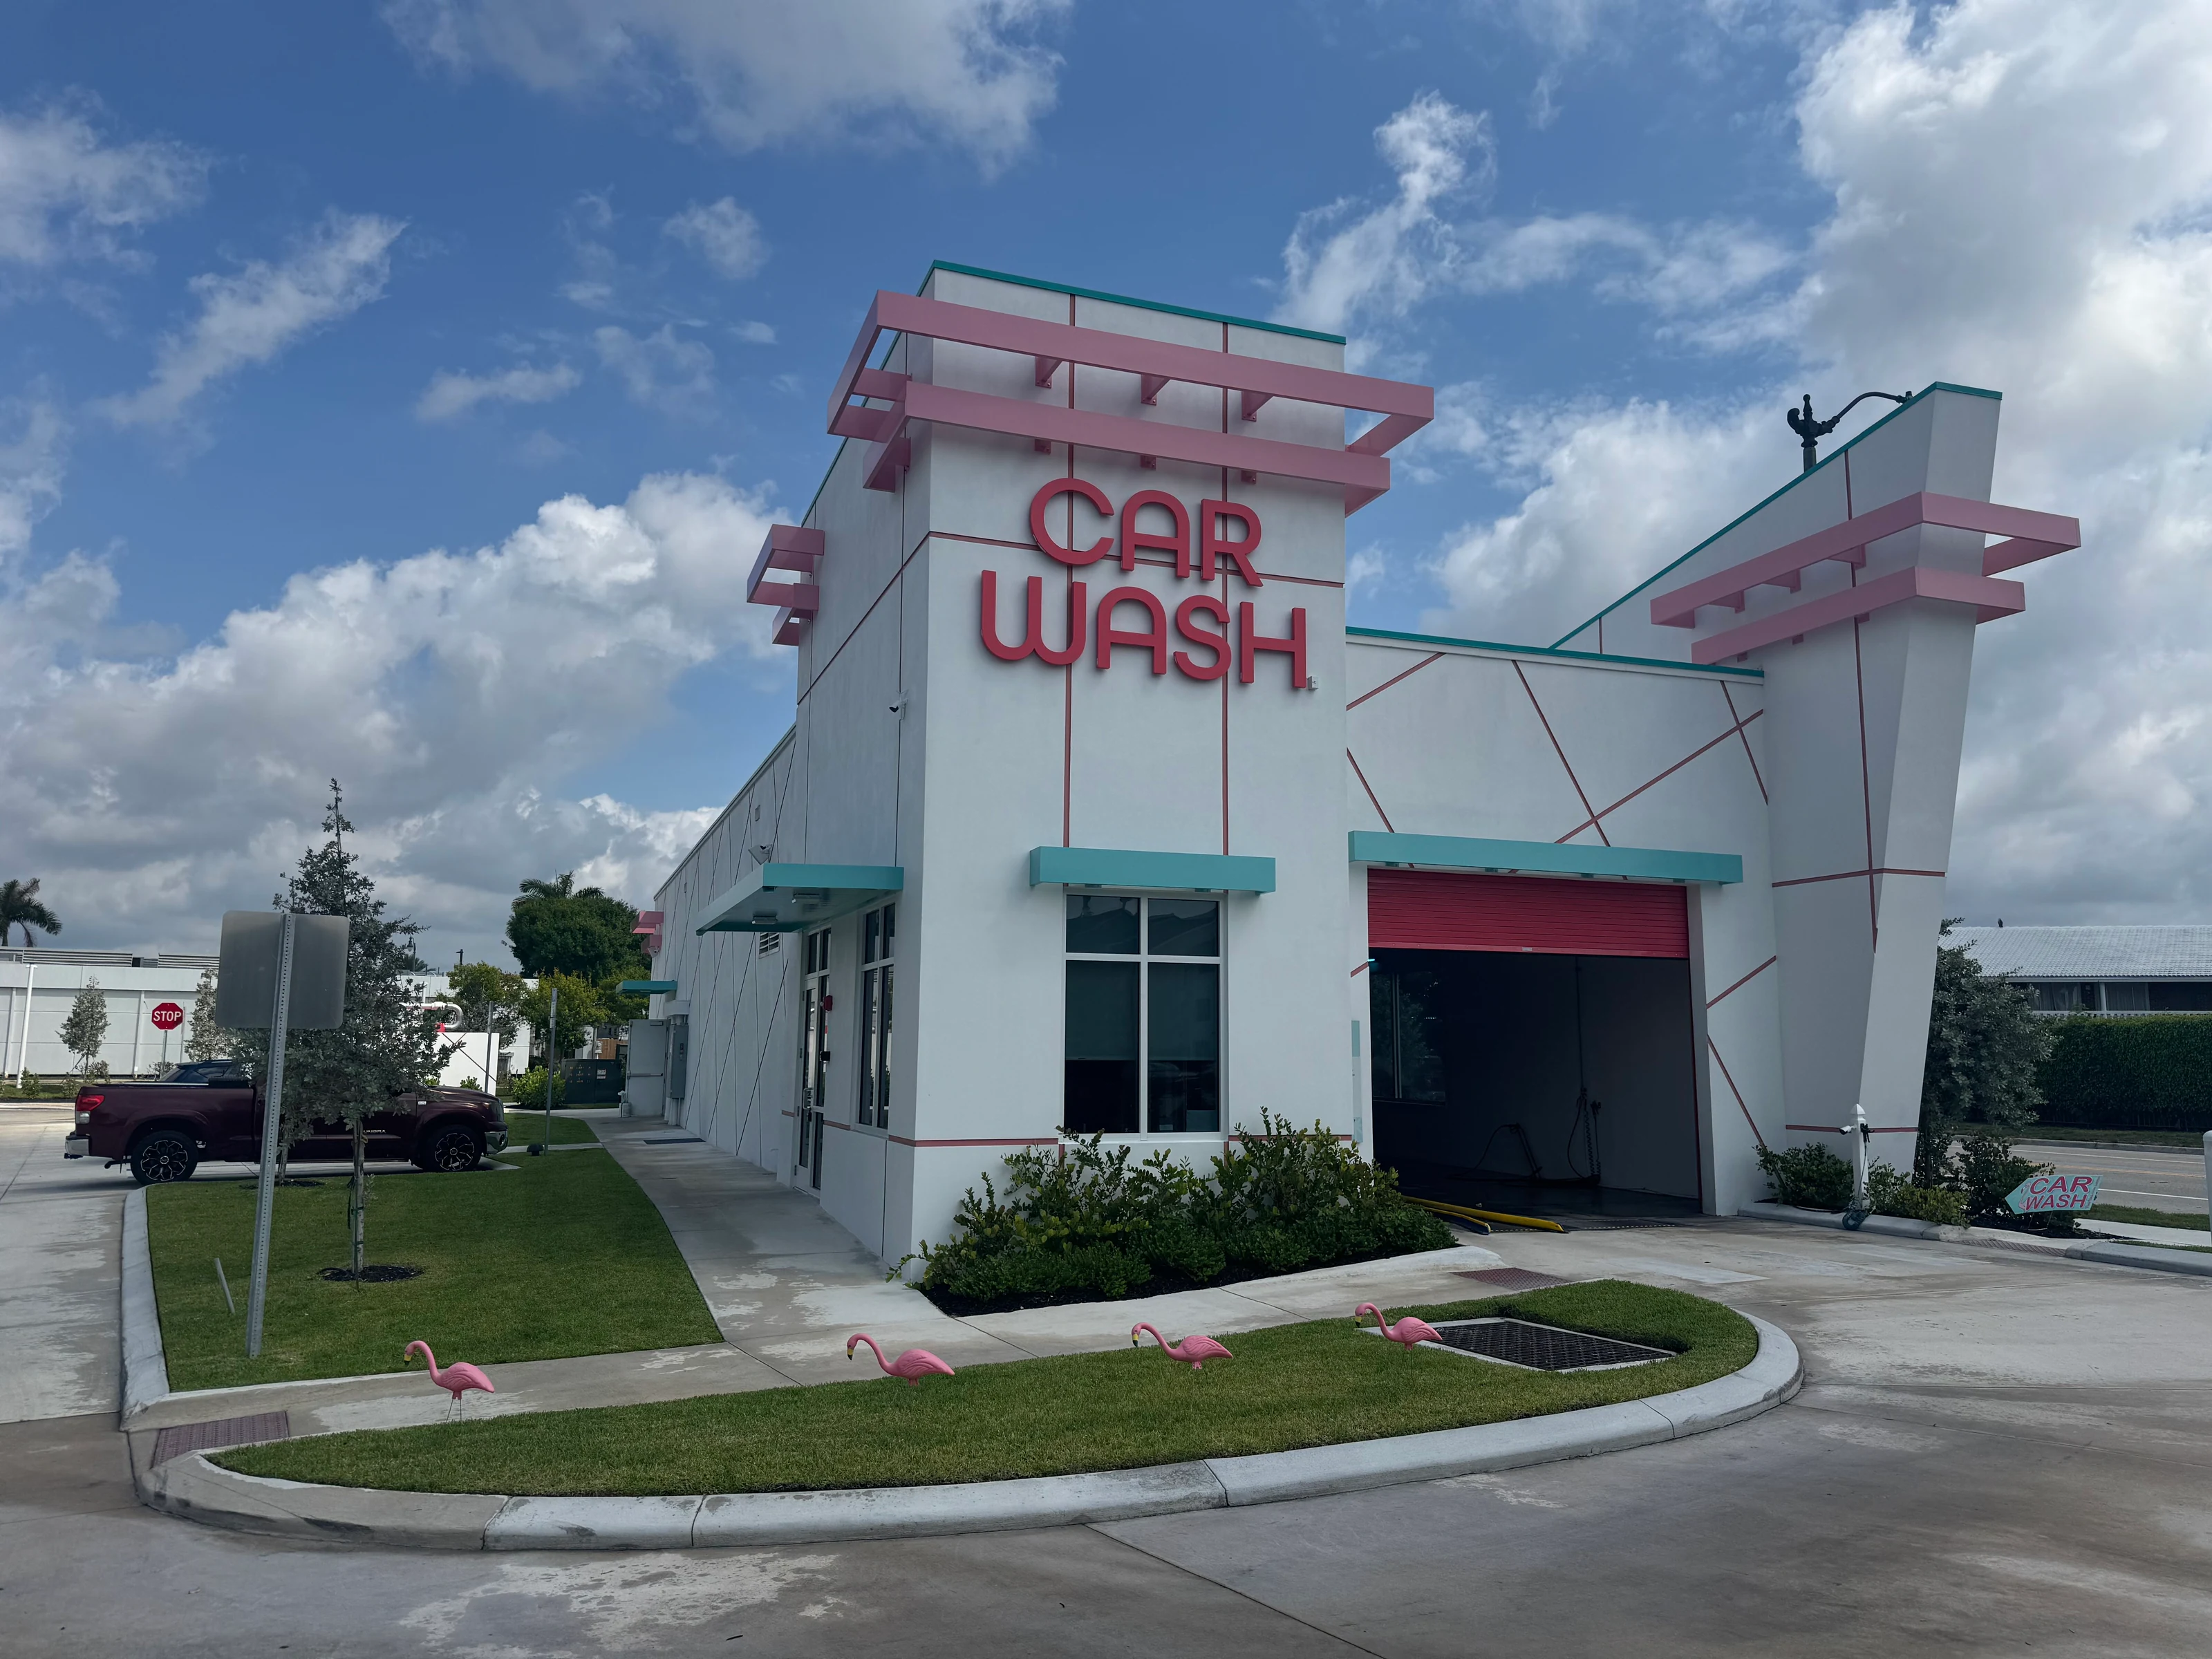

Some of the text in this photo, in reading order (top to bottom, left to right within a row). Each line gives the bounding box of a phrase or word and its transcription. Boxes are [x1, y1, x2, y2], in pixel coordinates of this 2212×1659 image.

[1029, 477, 1264, 587] CAR
[981, 570, 1306, 688] WASH
[153, 1011, 182, 1022] STOP
[2030, 1176, 2092, 1194] CAR
[2025, 1194, 2087, 1210] WASH
